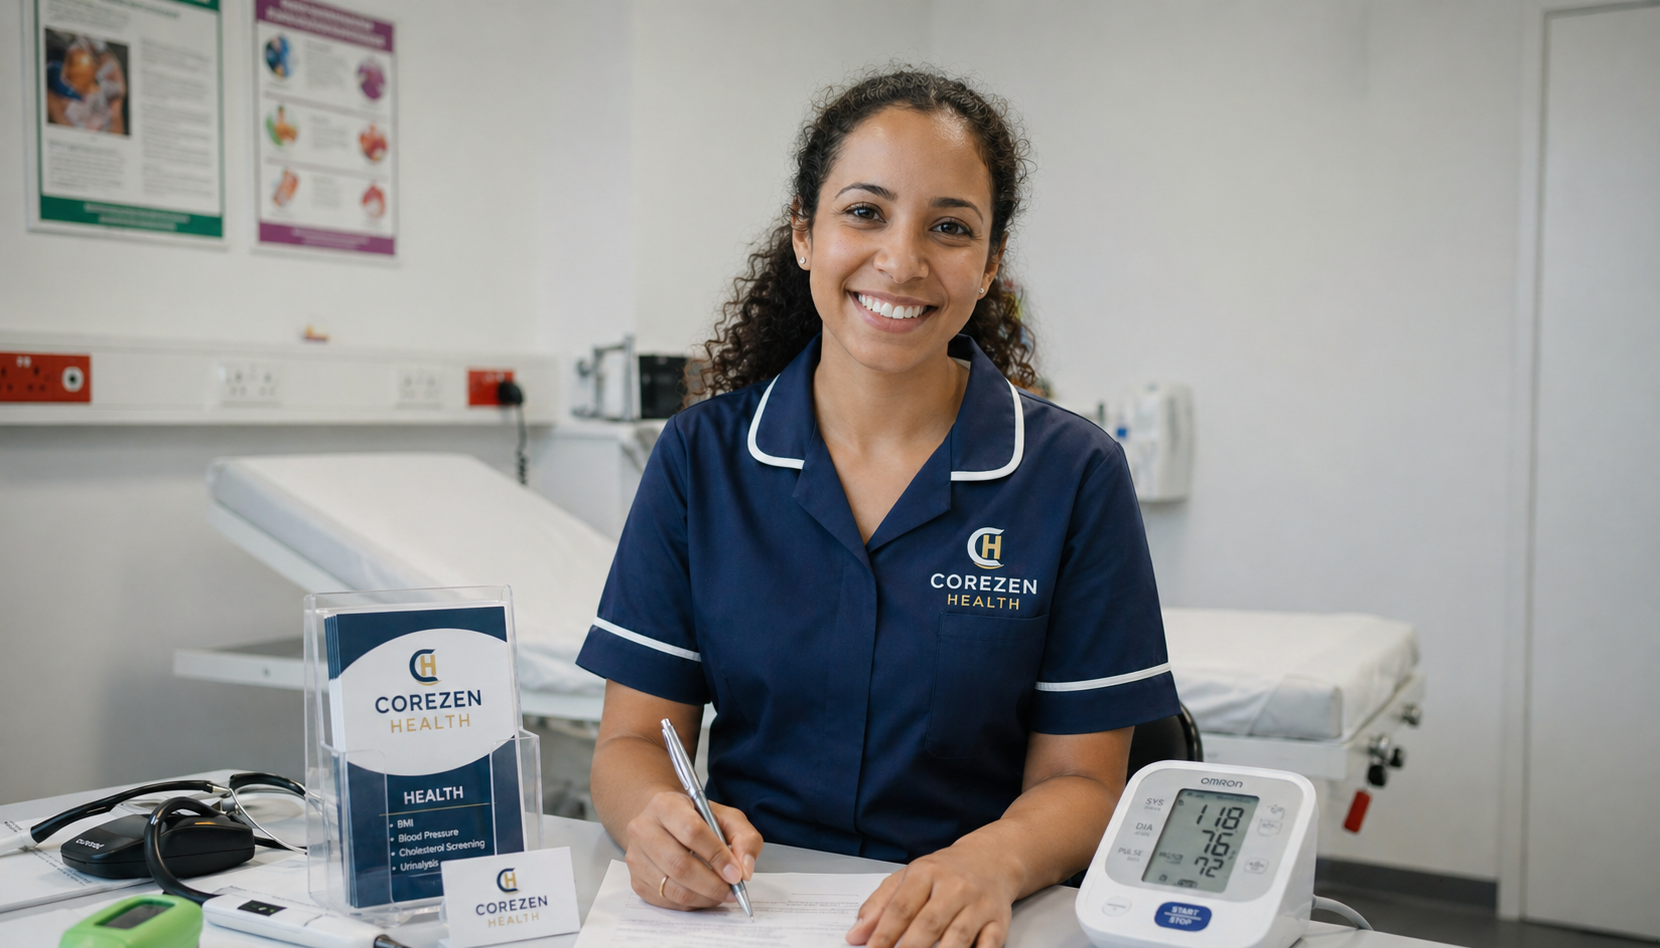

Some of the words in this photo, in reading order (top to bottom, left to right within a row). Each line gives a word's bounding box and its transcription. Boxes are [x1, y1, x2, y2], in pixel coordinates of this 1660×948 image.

[930, 573, 1037, 595] COREZEN
[947, 594, 1020, 610] HEALTH
[375, 689, 482, 714] COREZEN
[390, 713, 471, 734] HEALTH
[1201, 777, 1243, 788] OMRON
[403, 786, 464, 805] HEALTH
[1145, 797, 1164, 806] SYS
[397, 818, 414, 829] BMI
[1196, 804, 1245, 830] 118
[1136, 822, 1153, 831] DIA
[398, 832, 422, 843] Blood
[424, 828, 459, 840] Pressure
[1202, 829, 1230, 857] 76
[399, 843, 445, 857] Cholesterol
[446, 840, 485, 851] Screening
[1118, 847, 1143, 857] PULSE
[400, 859, 439, 872] Urinalysis
[1194, 856, 1224, 878] 72
[475, 895, 548, 916] COREZEN
[1171, 906, 1200, 916] START
[487, 912, 540, 928] HEALTH
[1168, 916, 1193, 926] STOP
